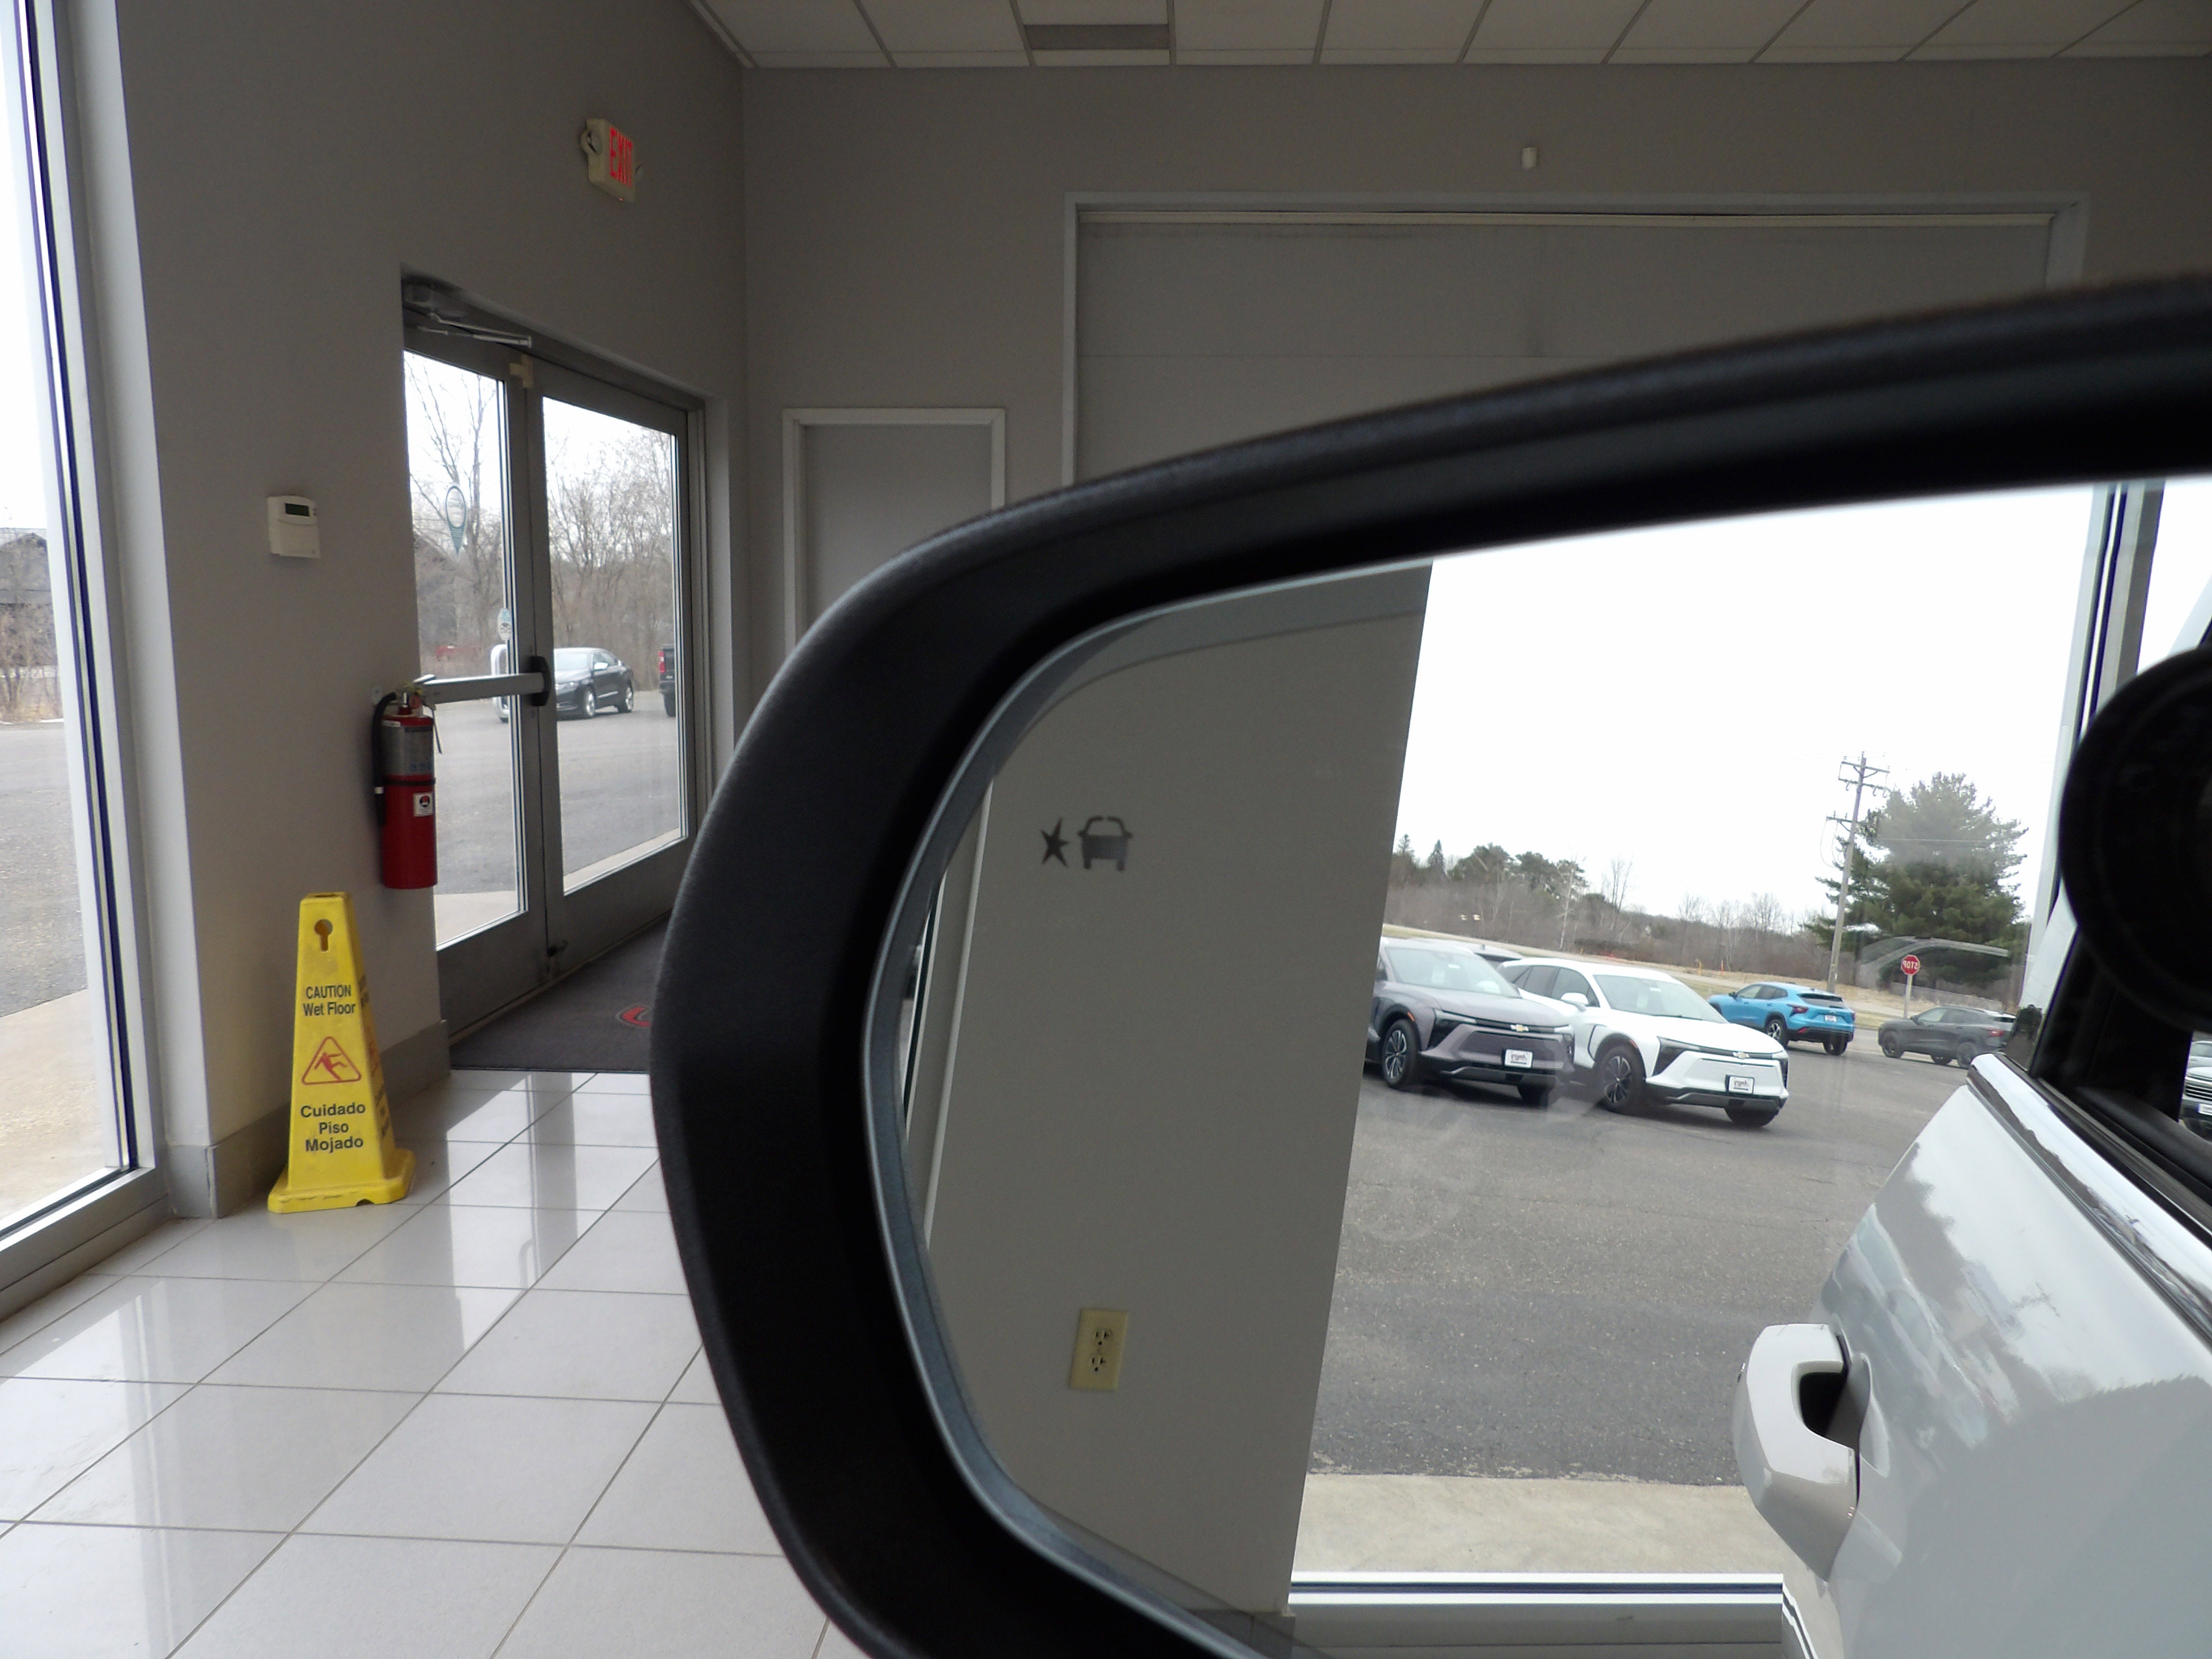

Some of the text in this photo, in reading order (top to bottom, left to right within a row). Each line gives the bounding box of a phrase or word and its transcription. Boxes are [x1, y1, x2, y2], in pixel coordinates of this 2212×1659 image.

[610, 128, 633, 187] EXIT
[306, 985, 351, 999] CAUTION
[303, 1002, 356, 1016] Wet Floor
[301, 1102, 365, 1118] Cuidado
[319, 1122, 349, 1134] Piso
[305, 1136, 363, 1153] Mojado
